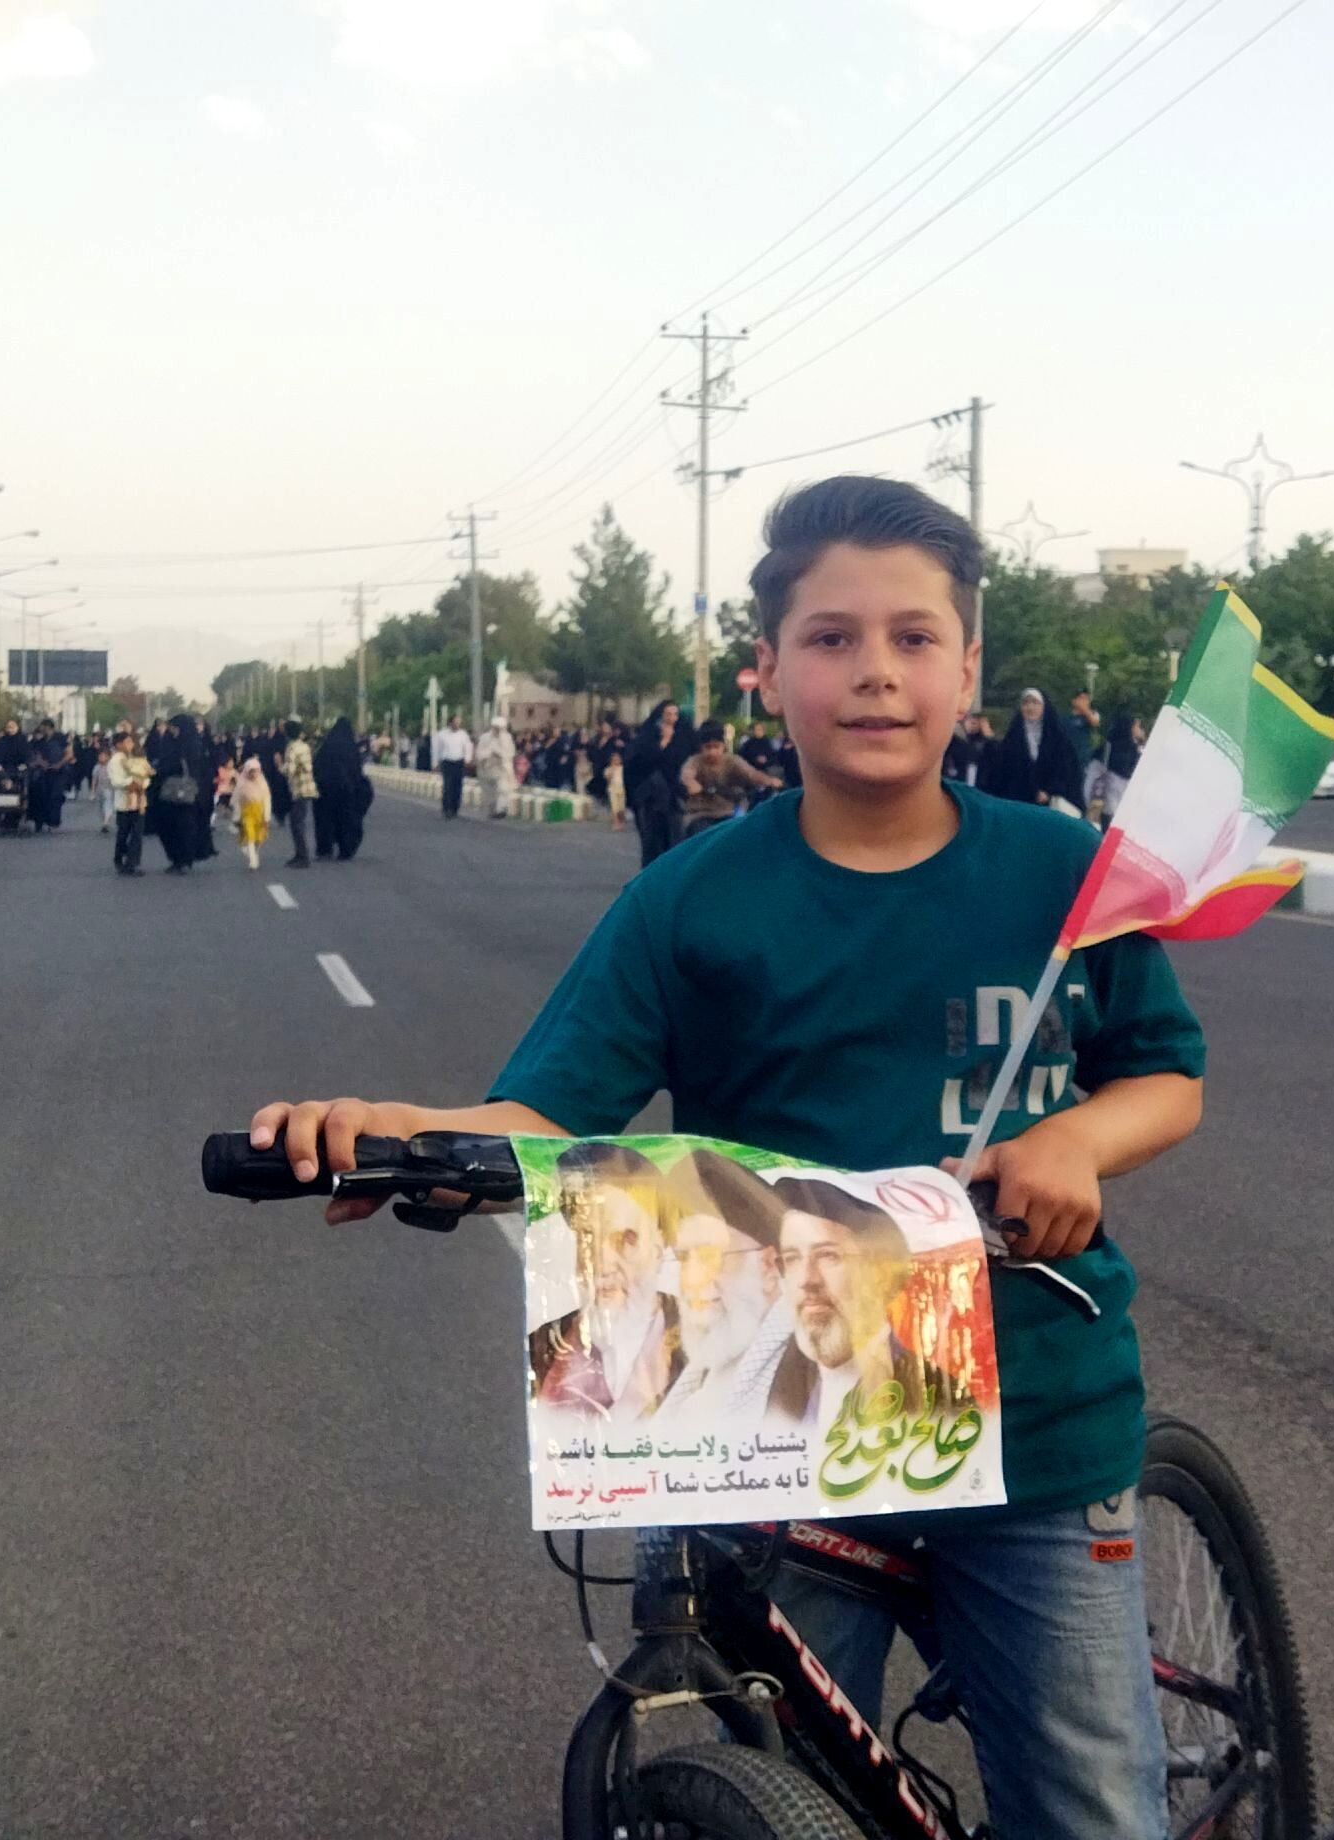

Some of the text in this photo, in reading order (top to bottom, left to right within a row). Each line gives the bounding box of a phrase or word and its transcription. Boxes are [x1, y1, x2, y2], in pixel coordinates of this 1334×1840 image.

[601, 1434, 653, 1464] فقیه
[658, 1434, 729, 1463] ولایت
[738, 1431, 808, 1461] پشتیبان
[546, 1466, 809, 1504] تا به مملکت شما آسیبی نرسد
